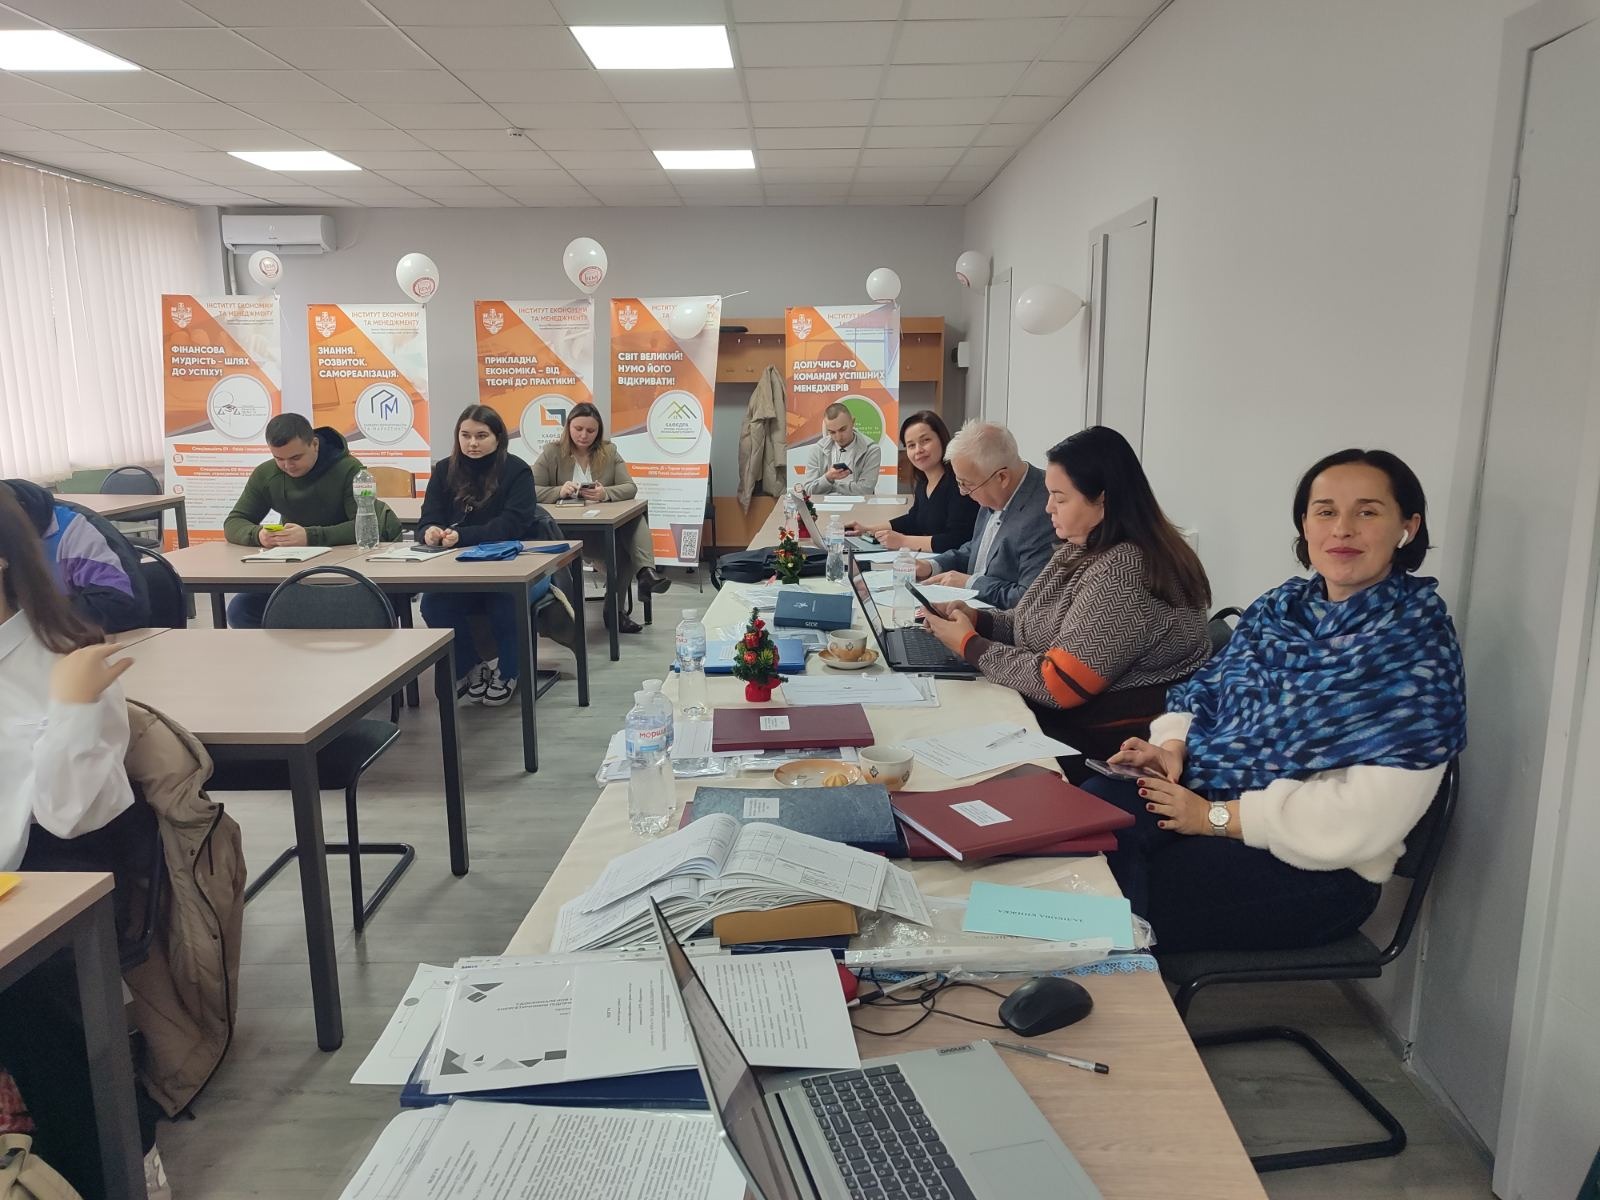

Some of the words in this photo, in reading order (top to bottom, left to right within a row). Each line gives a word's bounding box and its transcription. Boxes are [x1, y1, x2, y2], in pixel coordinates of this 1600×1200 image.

[171, 346, 225, 354] ФІНАНСОВА
[318, 346, 355, 354] ЗНАННЯ.
[618, 352, 639, 361] СВІТ
[640, 350, 683, 361] ВЕЛИКИЙ!
[171, 357, 217, 365] МУДРІСТЬ
[224, 357, 250, 365] ШЛЯХ
[318, 358, 367, 366] РОЗВИТОК.
[485, 356, 538, 365] ПРИКЛАДНА
[793, 360, 841, 369] ДОЛУЧИСЬ
[843, 360, 857, 369] ДО
[171, 368, 186, 376] ДО
[188, 368, 223, 376] УСПІХУ!
[485, 367, 537, 375] ЕКОНОМІКА
[545, 366, 560, 375] ВІД
[618, 364, 645, 373] НУМО
[647, 363, 672, 373] ЙОГО
[319, 369, 399, 378] САМОРЕАЛІЗАЦІЯ.
[793, 373, 837, 381] КОМАНДИ
[839, 371, 885, 379] УСПІШНИХ
[486, 377, 513, 386] ТЕОРІЇ
[514, 378, 528, 387] ДО
[530, 377, 576, 385] ПРАКТИКИ!
[618, 376, 675, 386] ВІДКРИВАТИ!
[793, 384, 849, 393] МЕНЕДЖЕРІВ
